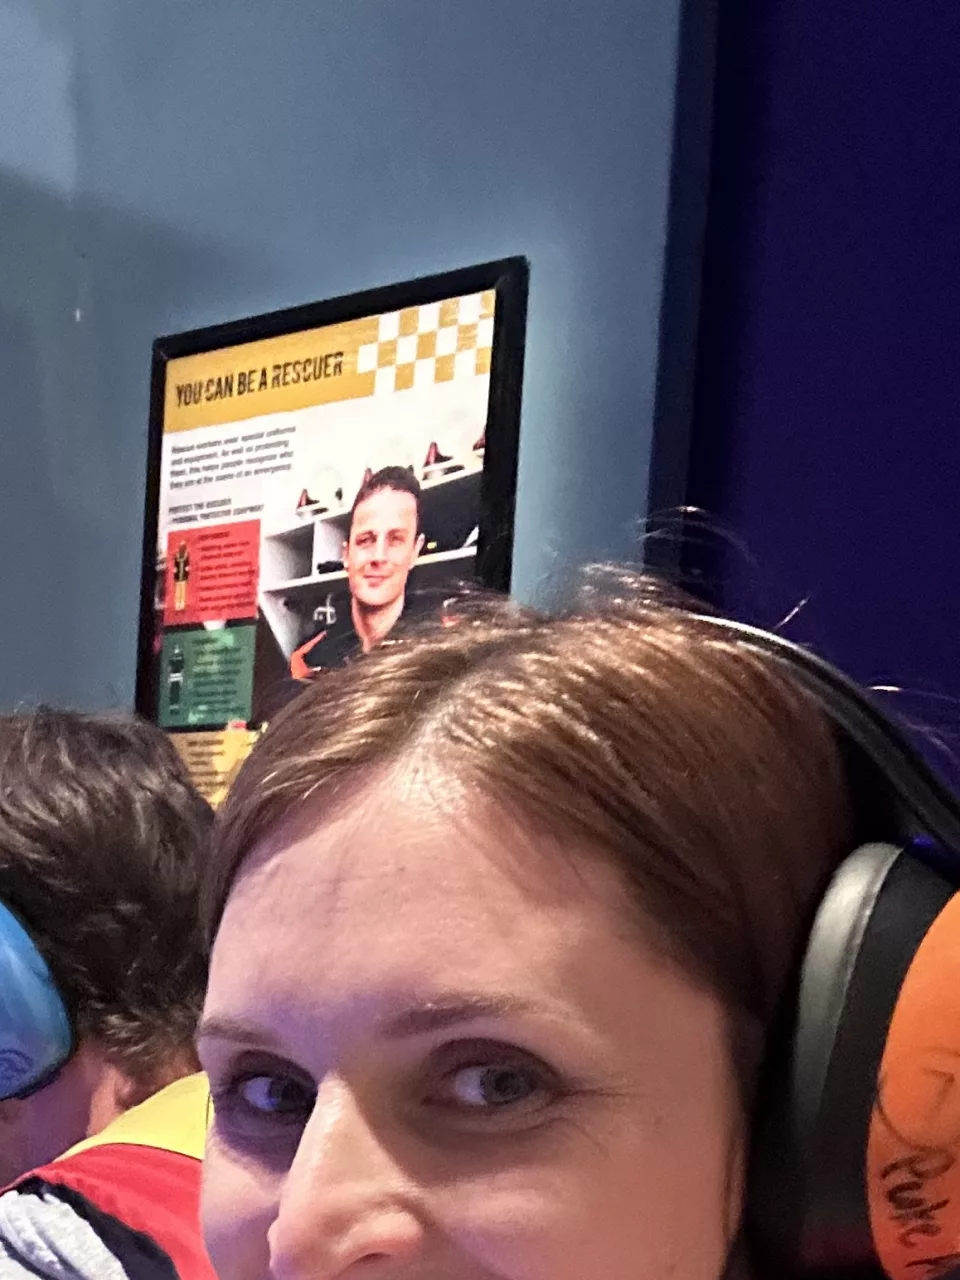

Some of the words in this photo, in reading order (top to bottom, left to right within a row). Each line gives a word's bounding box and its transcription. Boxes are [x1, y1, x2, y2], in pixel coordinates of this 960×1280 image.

[176, 380, 204, 408] YOU
[204, 373, 234, 402] CAN
[236, 369, 258, 397] BE
[257, 367, 268, 392] A
[271, 351, 344, 389] RESCUER
